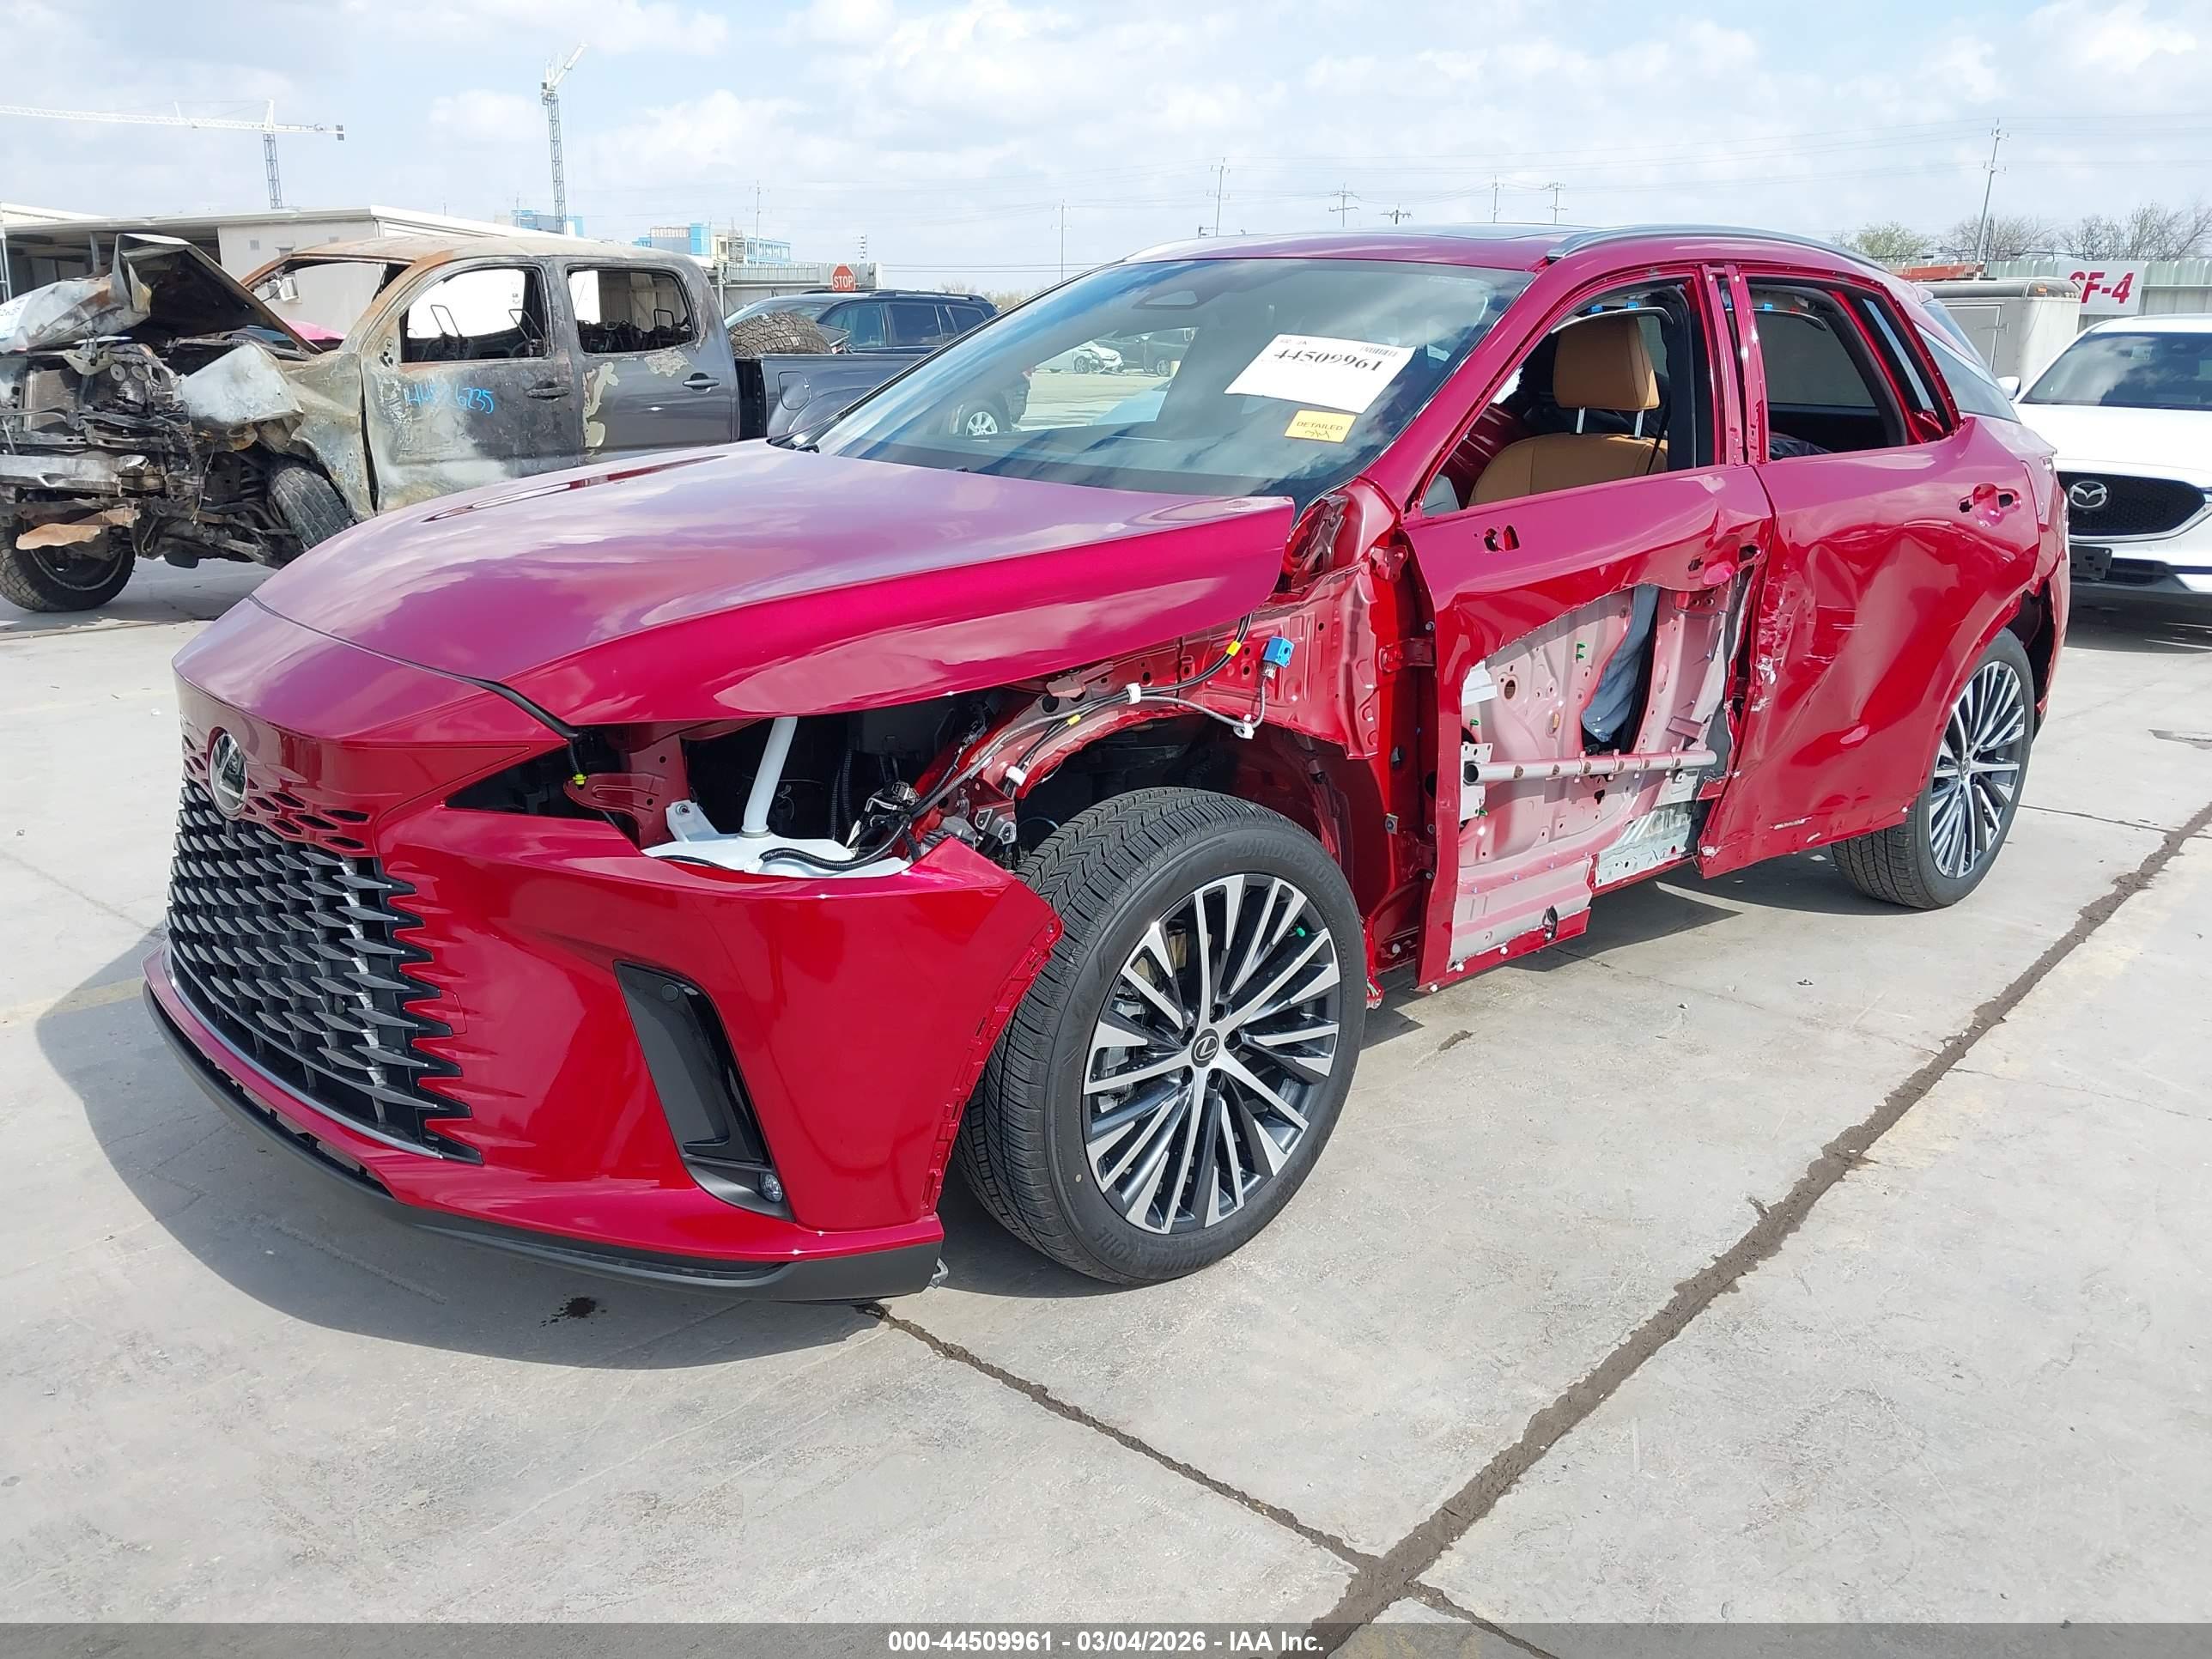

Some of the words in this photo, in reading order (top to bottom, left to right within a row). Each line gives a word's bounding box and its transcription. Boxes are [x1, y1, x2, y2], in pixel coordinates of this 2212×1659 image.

[833, 275, 854, 289] STOP
[1273, 349, 1383, 372] 44509961
[1296, 421, 1343, 431] DETAILED
